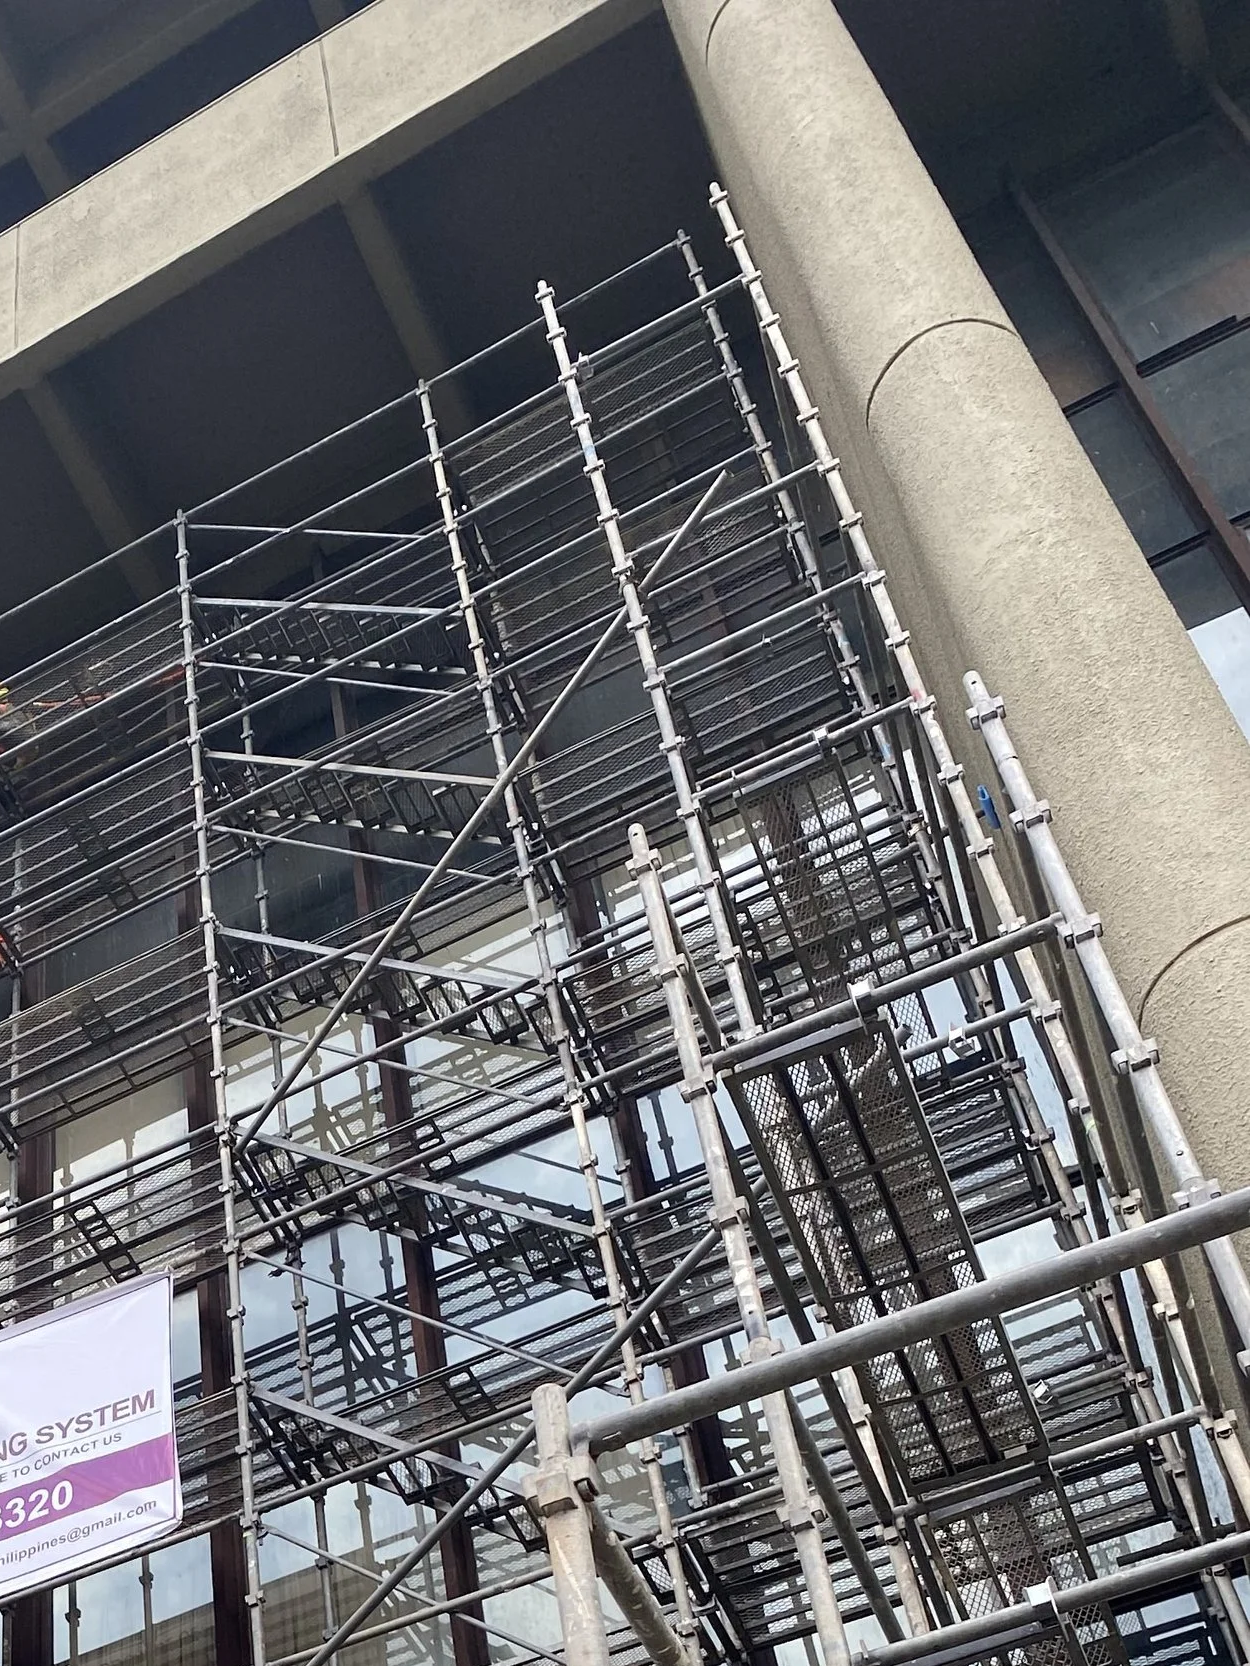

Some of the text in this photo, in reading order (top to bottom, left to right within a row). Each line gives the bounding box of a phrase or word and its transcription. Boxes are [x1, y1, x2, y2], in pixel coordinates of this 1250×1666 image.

[36, 1389, 155, 1445] SYSTEM
[12, 1465, 29, 1478] TO
[34, 1441, 97, 1470] CONTACT
[103, 1432, 122, 1445] US
